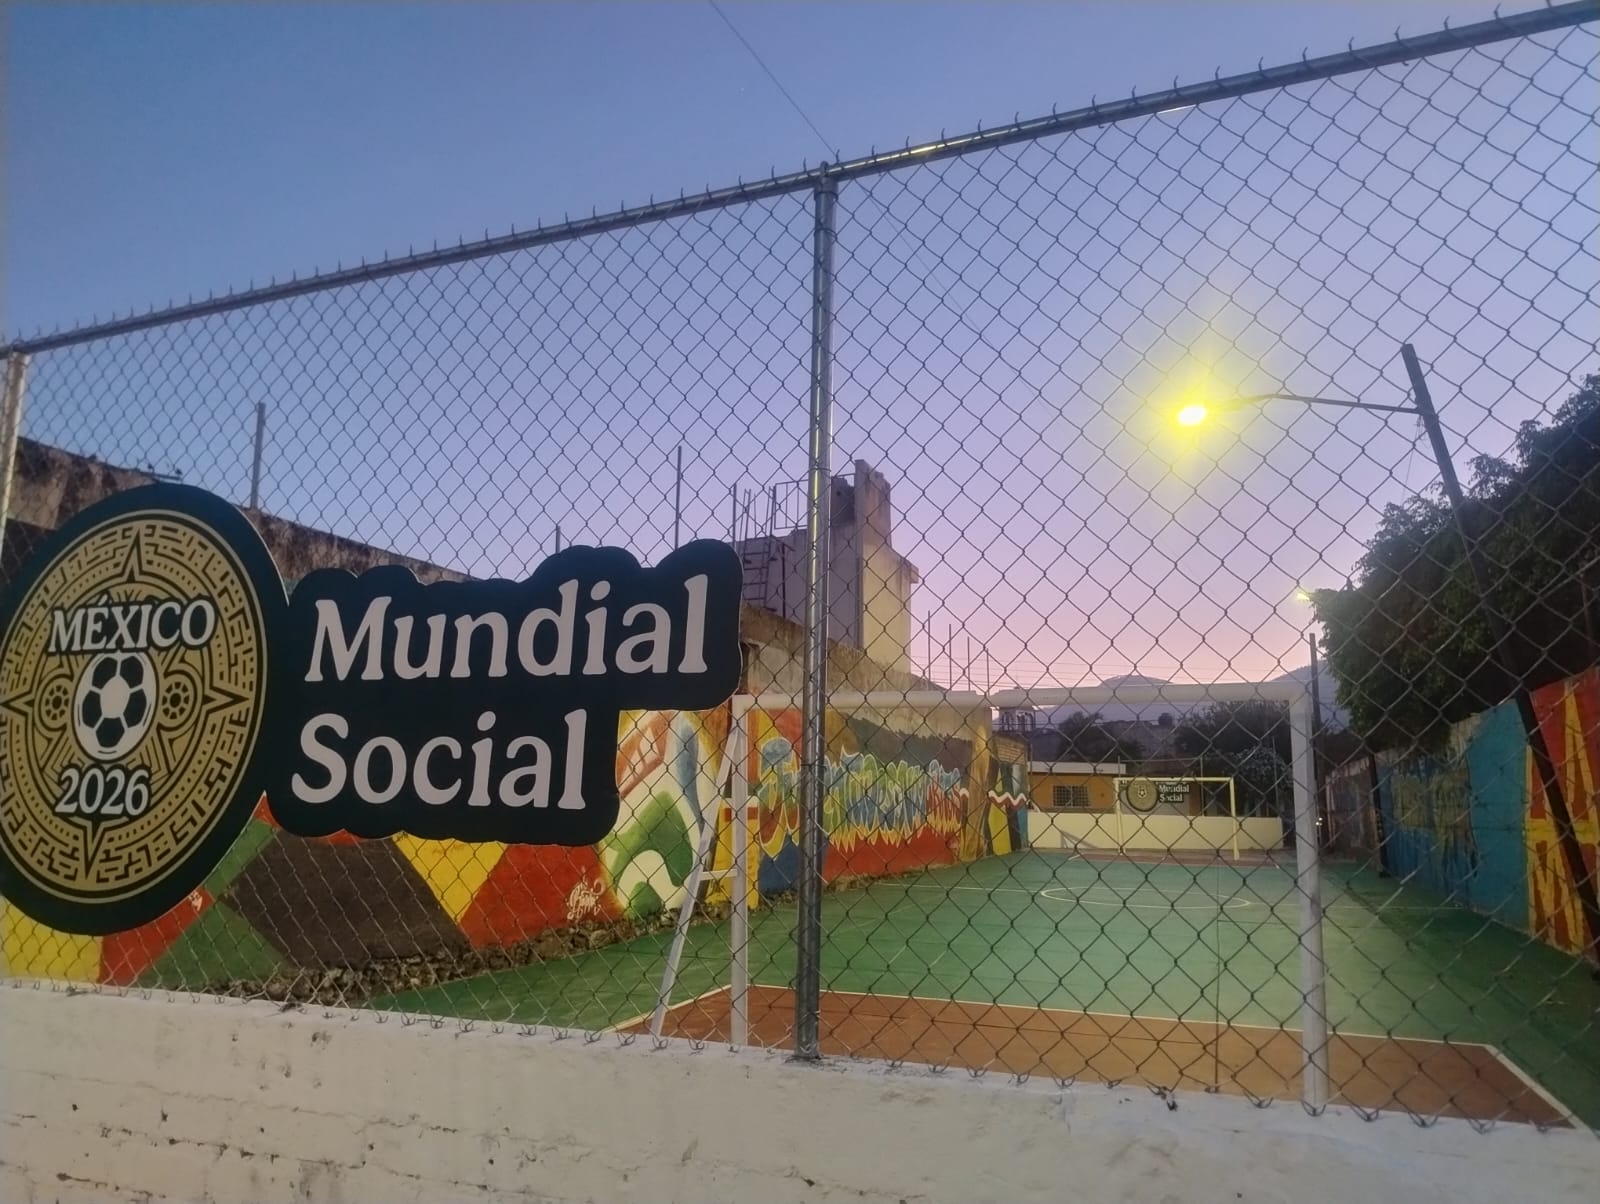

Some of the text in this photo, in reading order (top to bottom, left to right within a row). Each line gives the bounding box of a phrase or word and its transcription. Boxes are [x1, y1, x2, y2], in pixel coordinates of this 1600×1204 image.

[48, 594, 215, 652] MÉXICO
[305, 574, 708, 682] Mundial
[55, 767, 149, 815] 2026
[291, 708, 587, 809] Social
